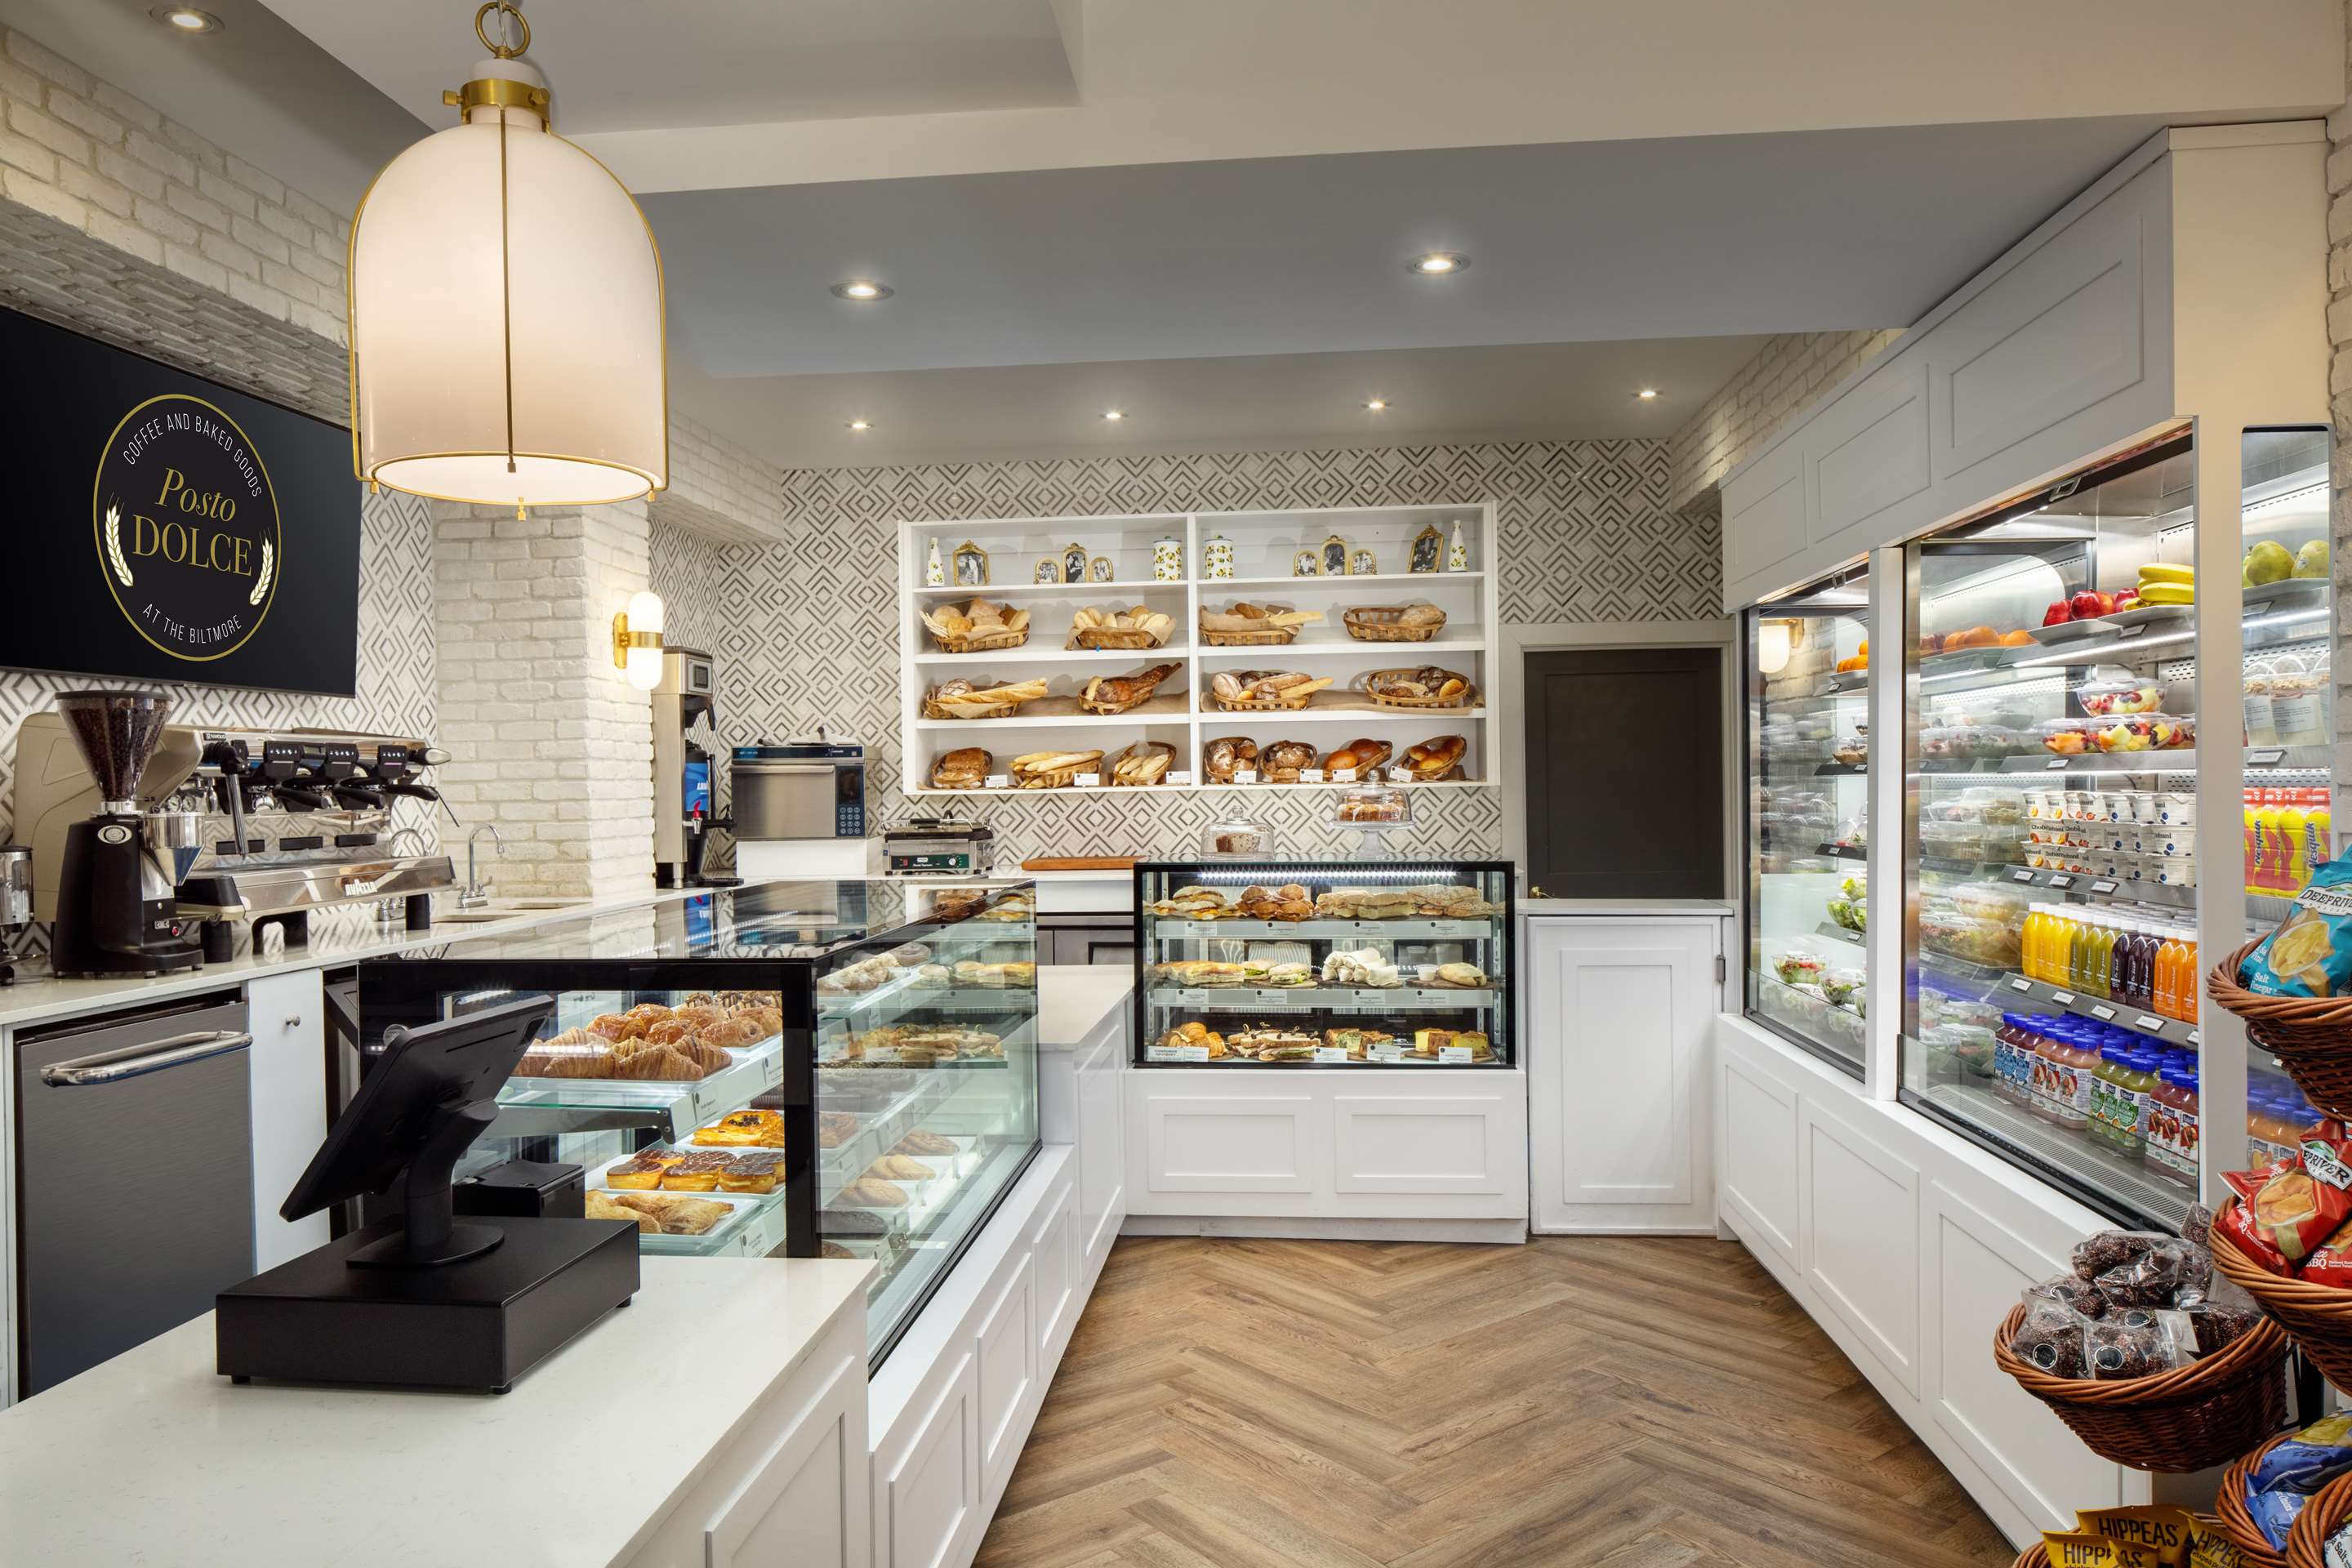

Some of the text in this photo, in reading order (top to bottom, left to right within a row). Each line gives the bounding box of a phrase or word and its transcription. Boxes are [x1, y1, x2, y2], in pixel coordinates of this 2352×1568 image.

[123, 413, 262, 497] COFFEE AND BAKED GOODS
[154, 467, 236, 522] Posto
[132, 514, 252, 577] DOLCE
[142, 604, 242, 644] AT THE BILTMORE
[2254, 820, 2264, 864] Nesquik
[2306, 822, 2320, 870] Nesquik
[2251, 980, 2273, 995] inegar
[2254, 972, 2270, 984] Salt
[2098, 1517, 2179, 1548] HIPPEAS
